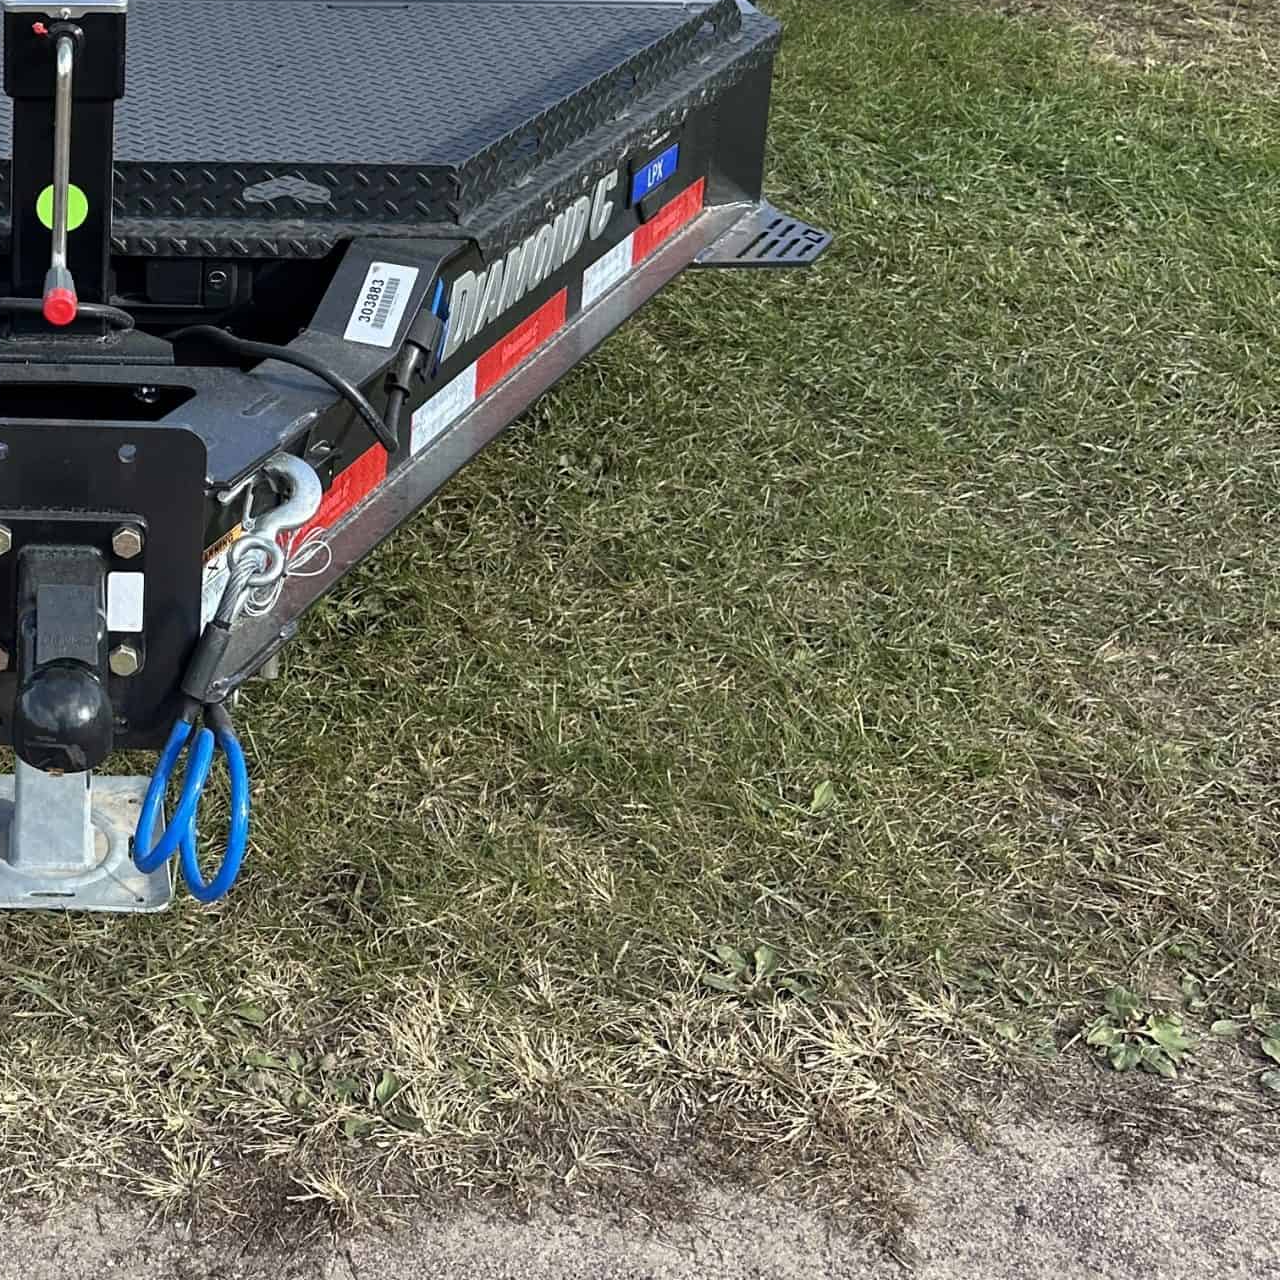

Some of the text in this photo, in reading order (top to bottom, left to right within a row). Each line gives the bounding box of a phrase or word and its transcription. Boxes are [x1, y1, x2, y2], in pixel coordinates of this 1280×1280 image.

[647, 158, 664, 188] LPX
[440, 169, 618, 363] DIAMOND C
[358, 279, 385, 323] 303883
